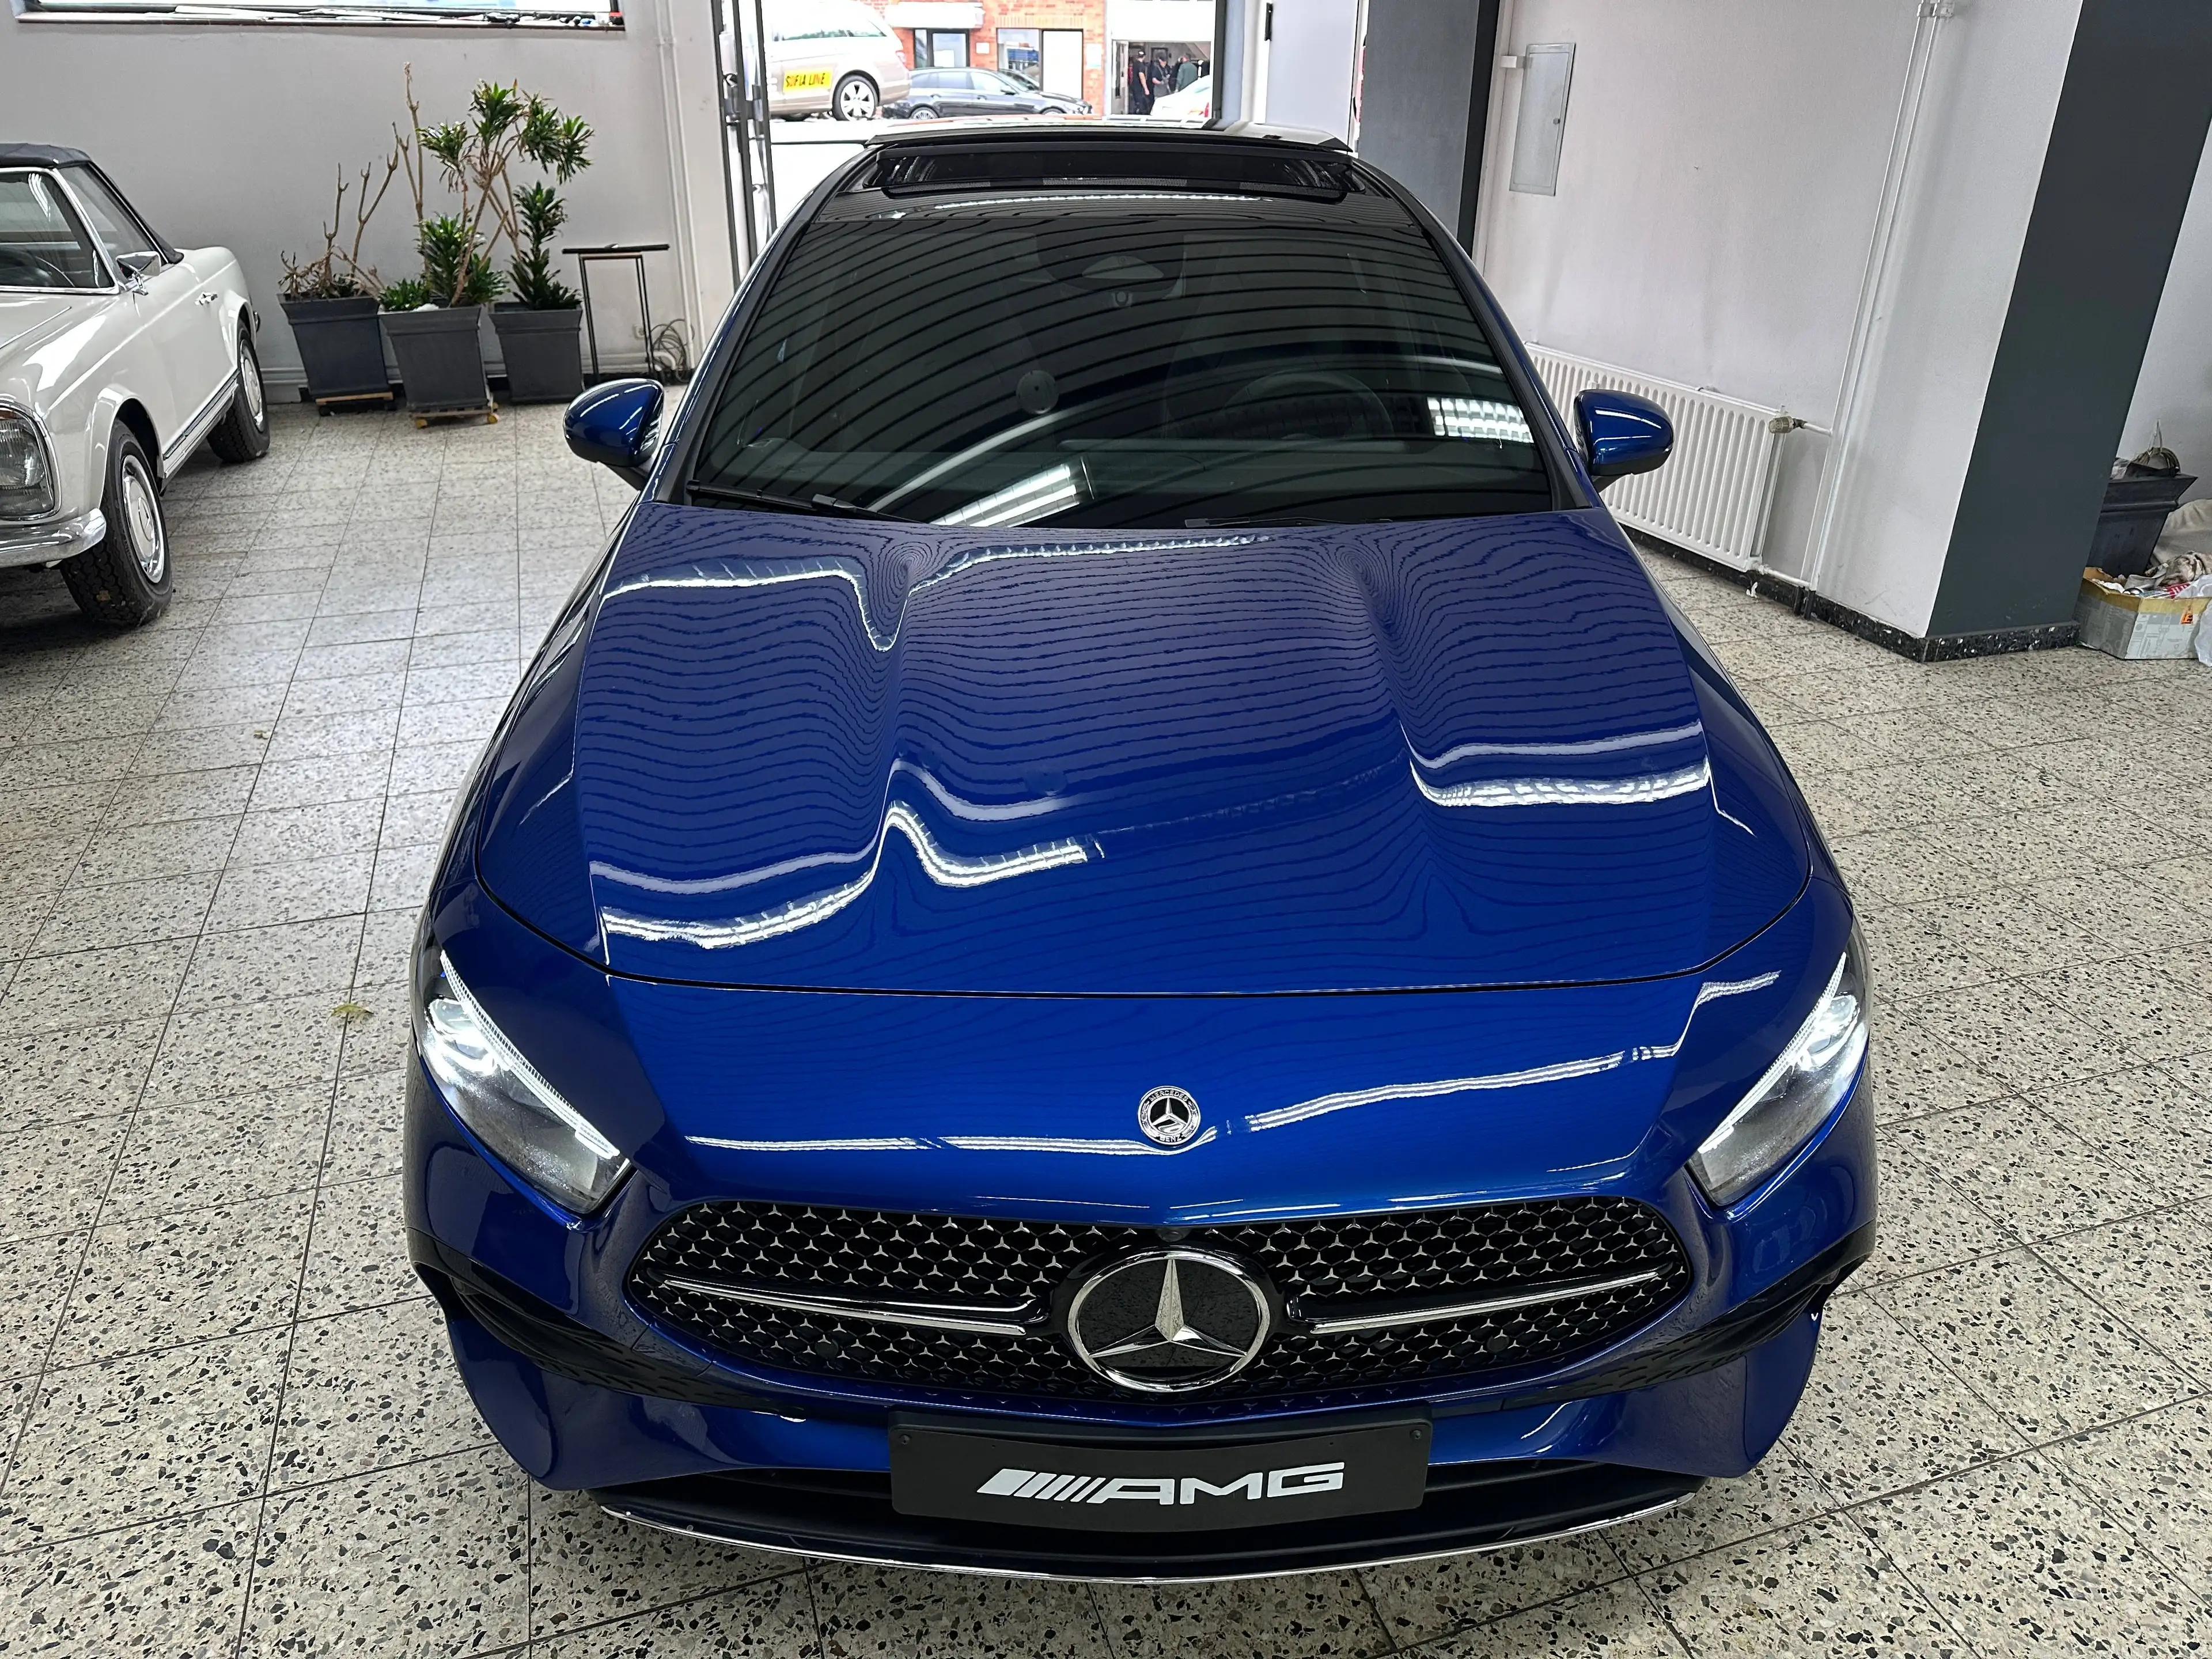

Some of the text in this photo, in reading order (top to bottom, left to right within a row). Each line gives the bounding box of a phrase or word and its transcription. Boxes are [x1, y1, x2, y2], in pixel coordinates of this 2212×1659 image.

[1149, 1090, 1188, 1103] MERCEDES
[1160, 1134, 1182, 1142] BENZ
[1086, 1462, 1345, 1504] AMG
